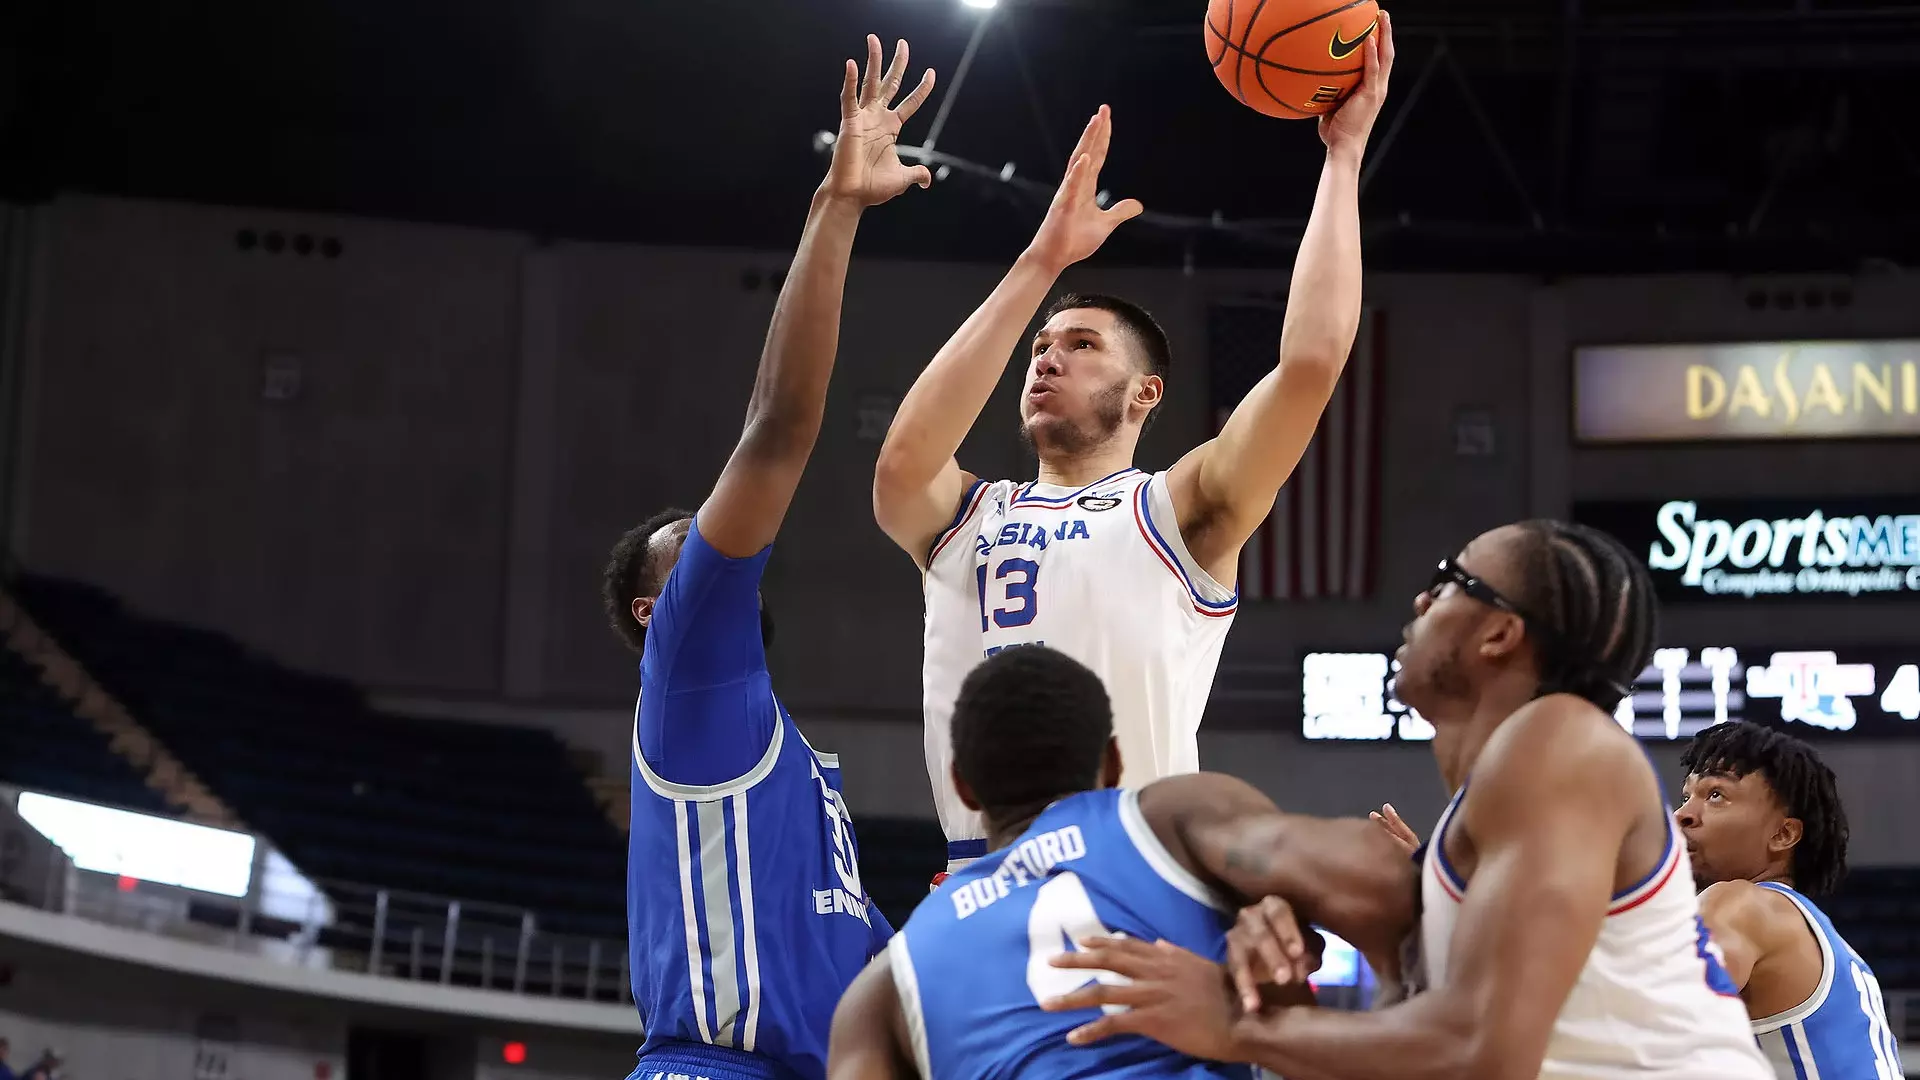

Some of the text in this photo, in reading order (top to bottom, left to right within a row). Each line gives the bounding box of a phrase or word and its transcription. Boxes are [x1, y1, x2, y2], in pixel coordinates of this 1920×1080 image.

[1686, 352, 1918, 426] DASANI
[950, 825, 1087, 920] BUFFORD
[1026, 870, 1134, 1014] 4
